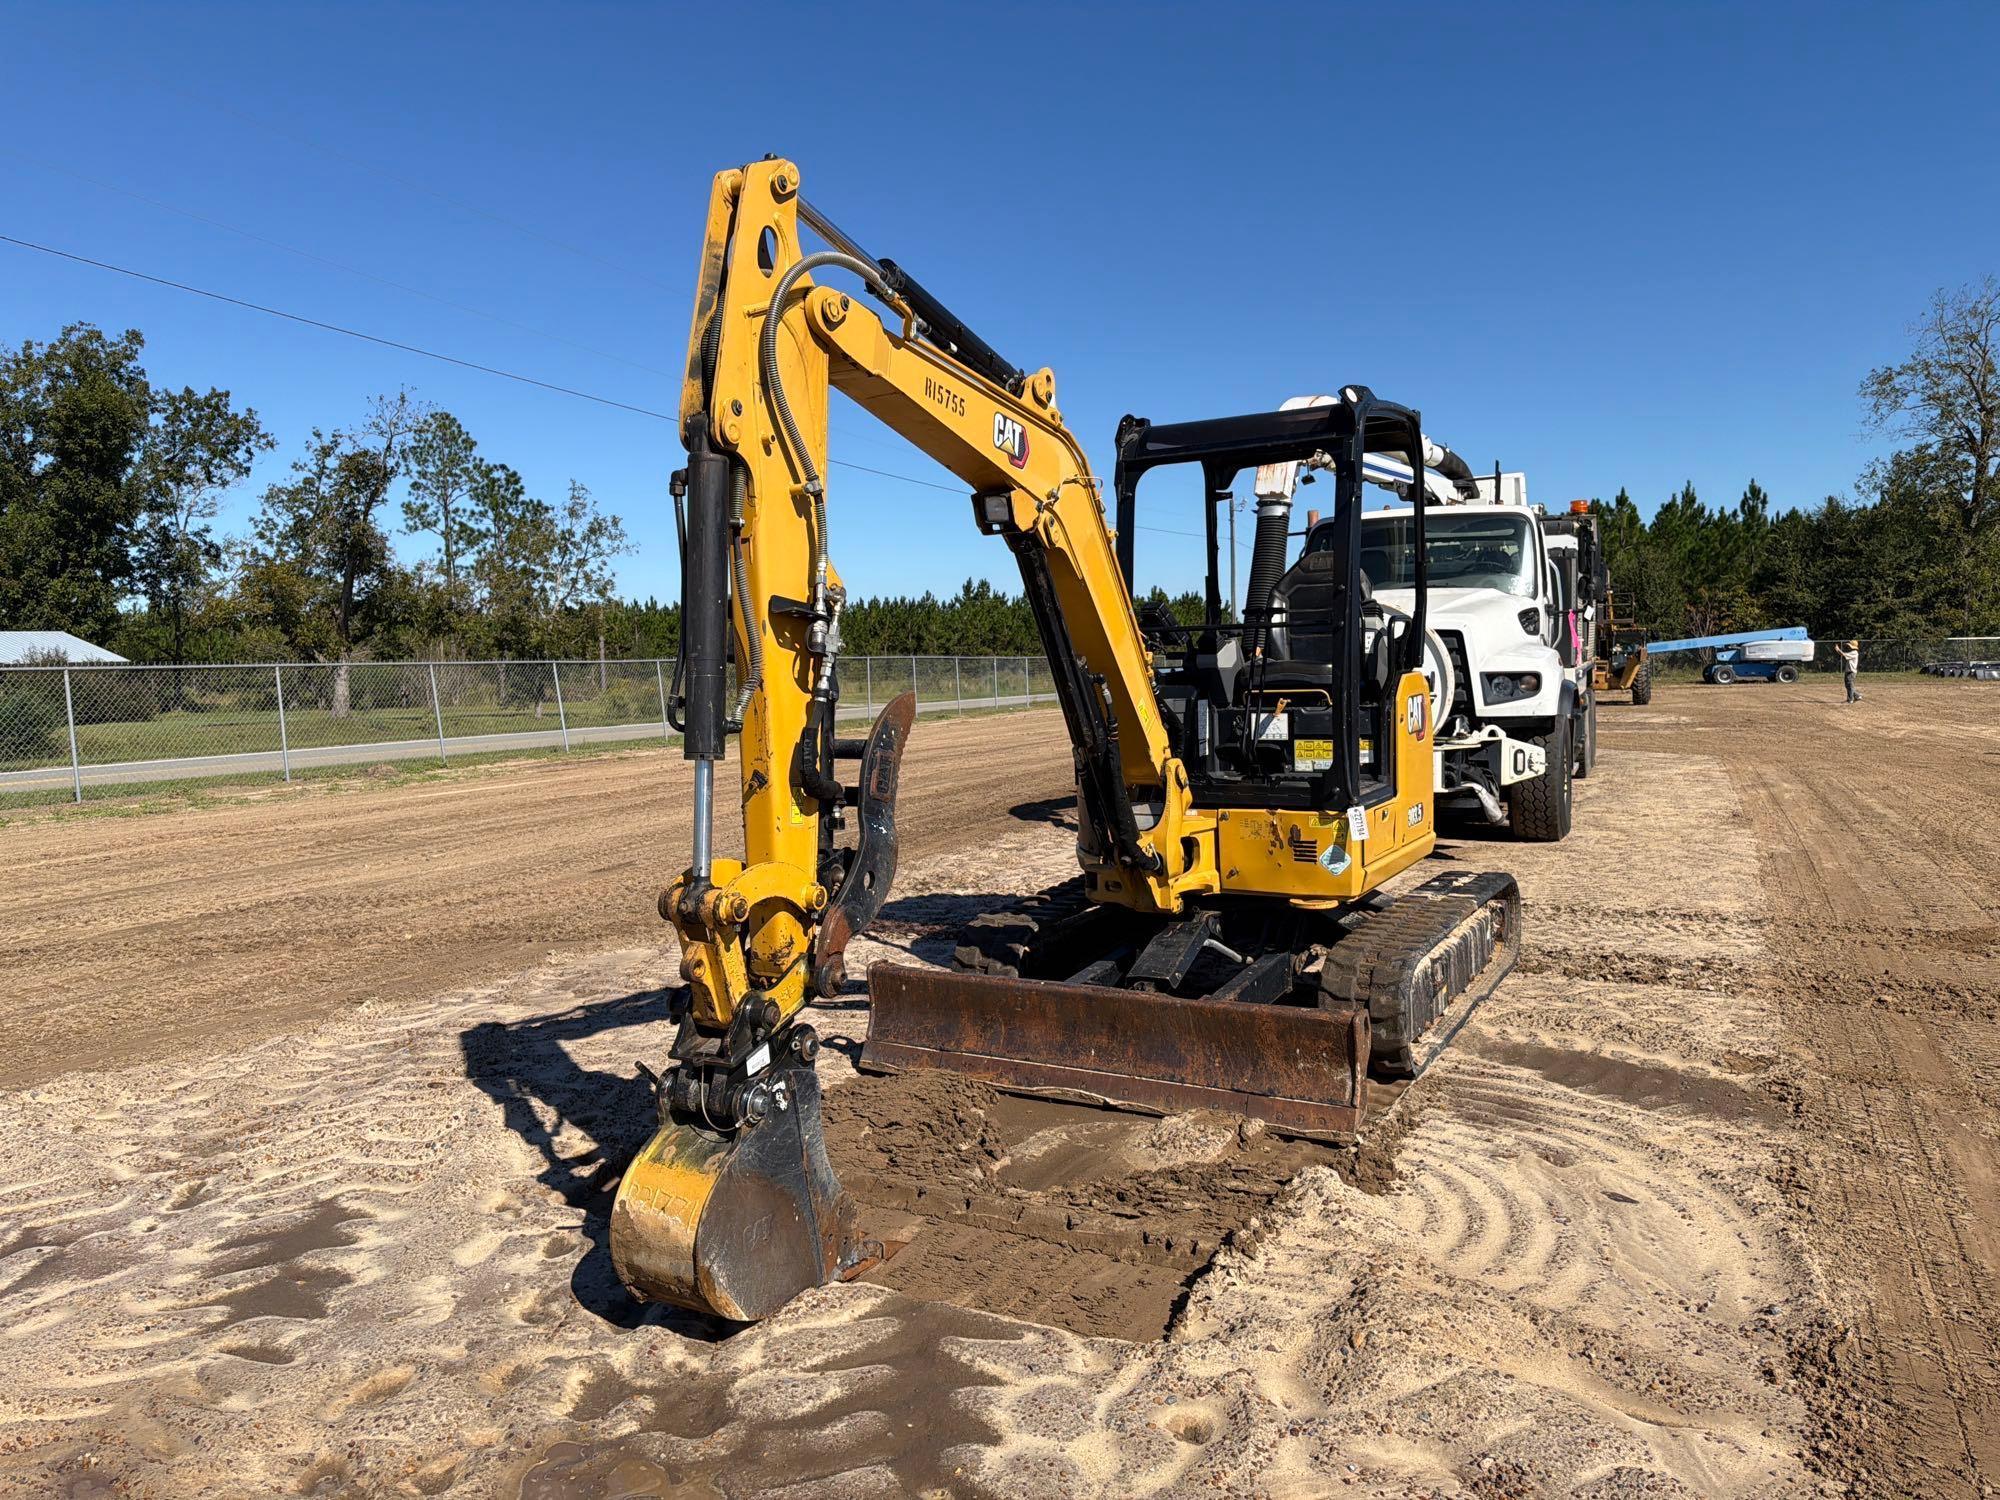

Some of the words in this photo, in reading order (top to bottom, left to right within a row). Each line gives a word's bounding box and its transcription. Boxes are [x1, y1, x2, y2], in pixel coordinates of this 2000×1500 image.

[994, 412, 1023, 457] CAT
[1407, 695, 1424, 733] CAT
[877, 754, 892, 795] CAT
